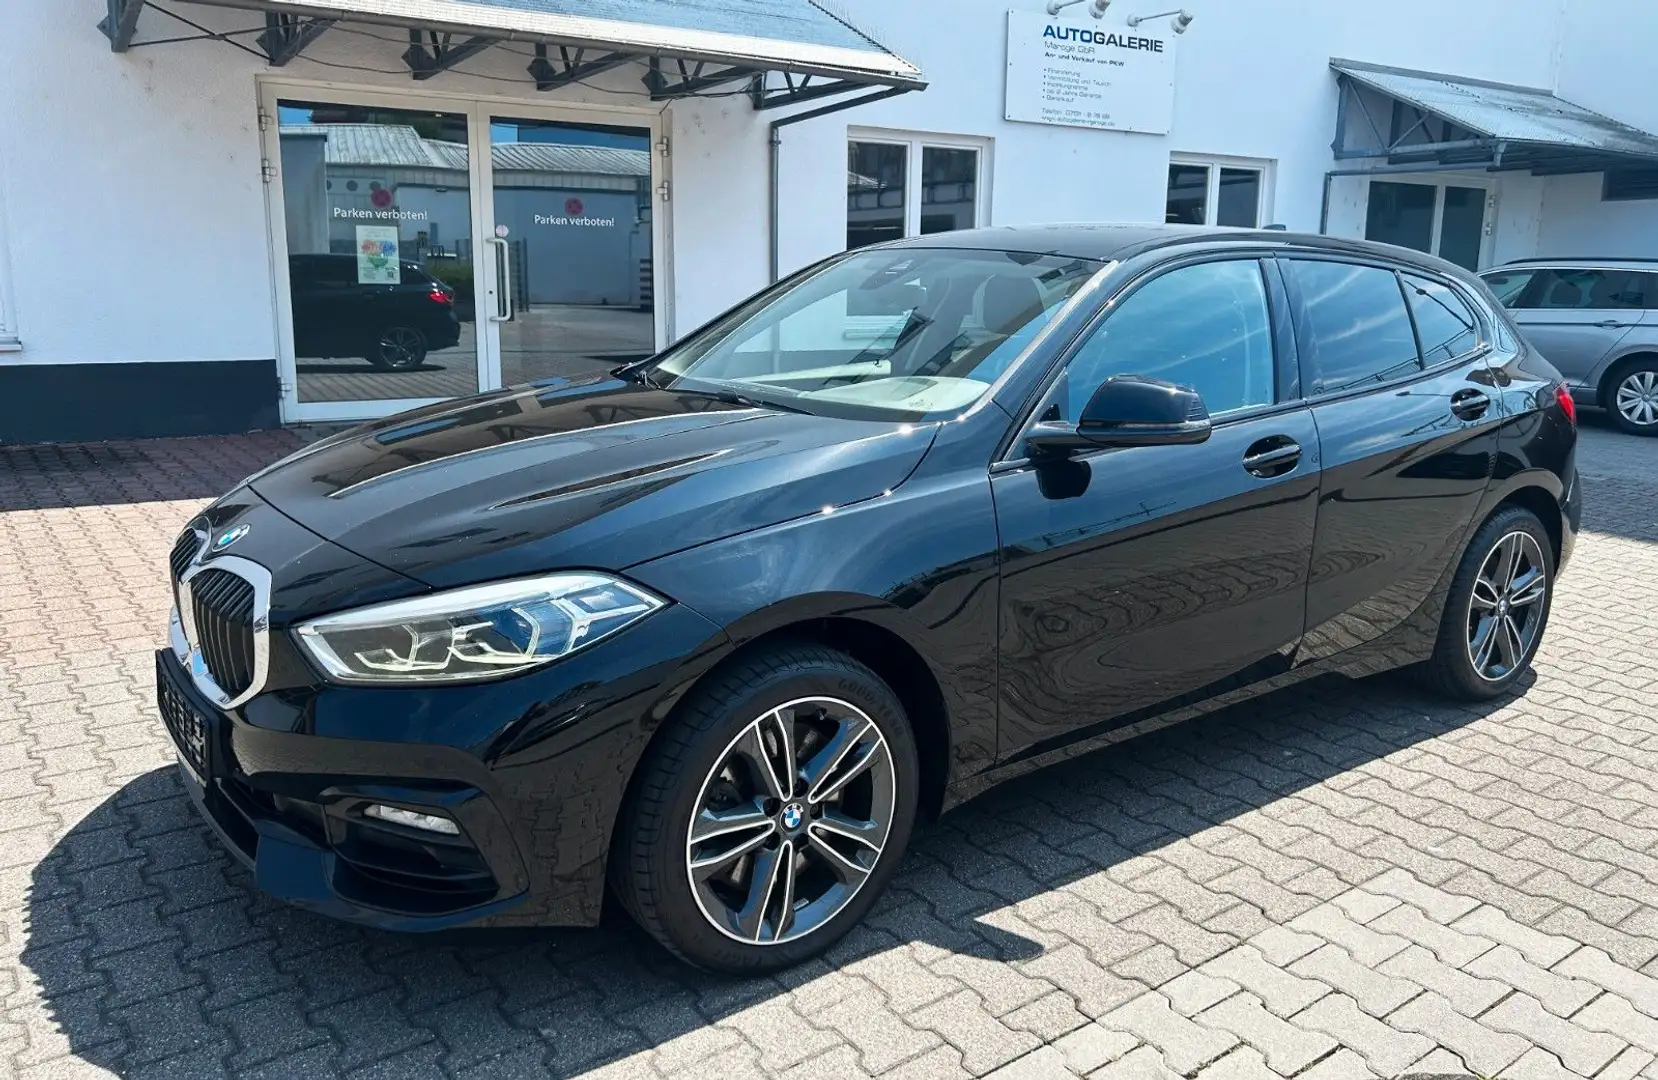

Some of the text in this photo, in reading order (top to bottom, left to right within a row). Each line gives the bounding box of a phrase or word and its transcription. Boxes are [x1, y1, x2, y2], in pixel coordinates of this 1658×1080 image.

[1043, 25, 1164, 53] AUTOGALERIE
[1071, 55, 1096, 63] Verkauf
[1109, 59, 1125, 67] PKW
[333, 207, 428, 220] Parken verboten!
[534, 214, 615, 227] Parken verboten!
